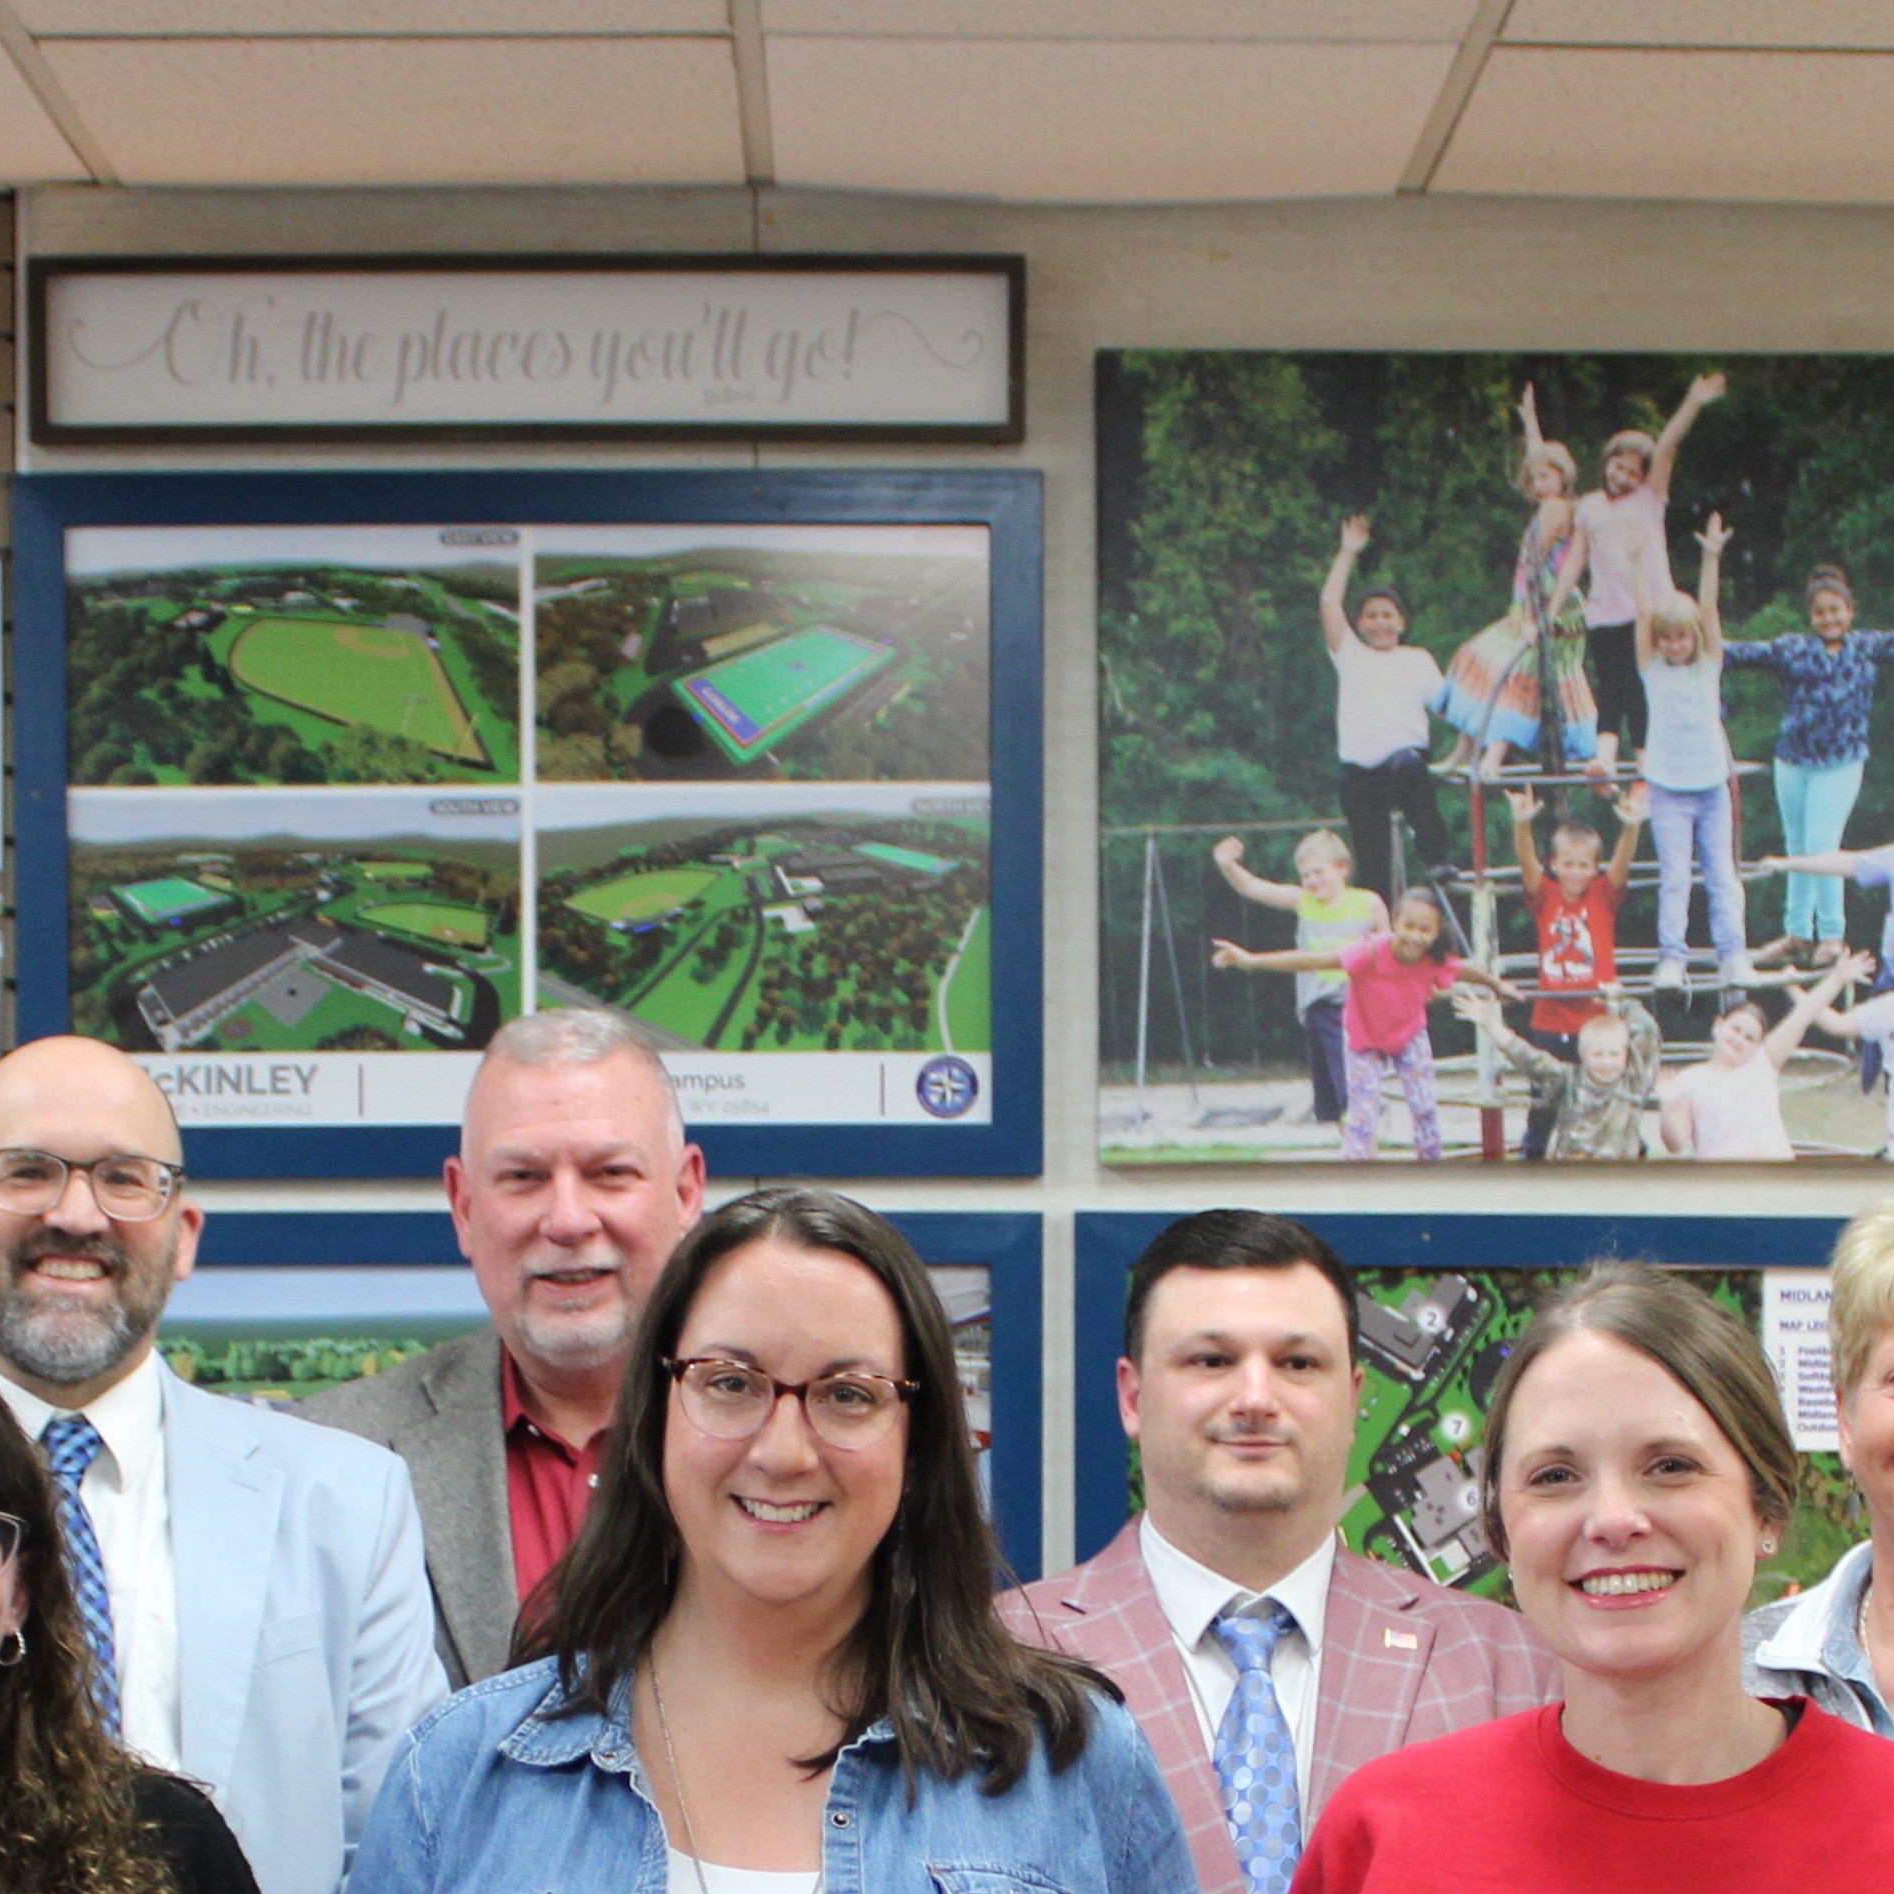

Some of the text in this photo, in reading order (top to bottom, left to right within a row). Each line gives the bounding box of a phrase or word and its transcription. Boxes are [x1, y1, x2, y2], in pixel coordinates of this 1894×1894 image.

[302, 310, 372, 382] the
[387, 309, 572, 405] places
[591, 302, 749, 404] you'll
[155, 1064, 318, 1095] cKINLEY
[1426, 1311, 1438, 1328] 2
[1451, 1419, 1463, 1436] 7
